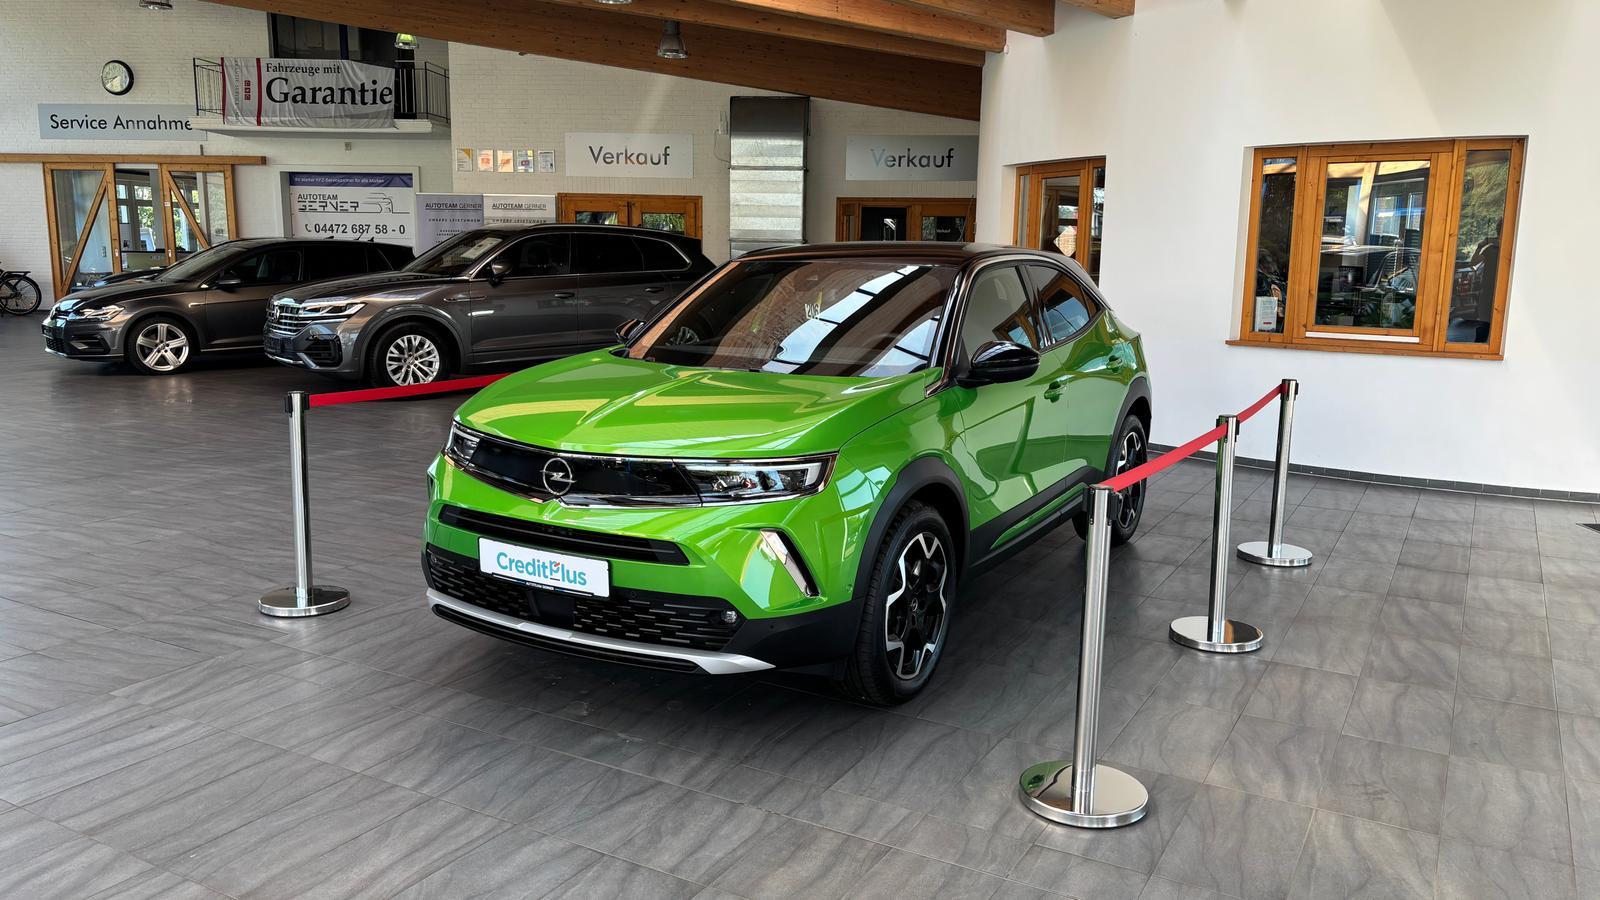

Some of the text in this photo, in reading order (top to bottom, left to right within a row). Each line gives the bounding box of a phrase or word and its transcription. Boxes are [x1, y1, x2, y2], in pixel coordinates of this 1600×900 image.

[266, 63, 341, 75] Fahrzeuge mit
[265, 77, 393, 106] Garantie
[50, 114, 193, 131] Service Annahme
[588, 145, 671, 166] Verkauf
[870, 148, 955, 168] Verkauf
[297, 193, 338, 201] AUTOTEAM
[314, 223, 348, 234] 04472
[351, 224, 371, 234] 687
[374, 224, 388, 234] 58
[399, 225, 406, 235] 0
[496, 551, 587, 586] CreditPlus
